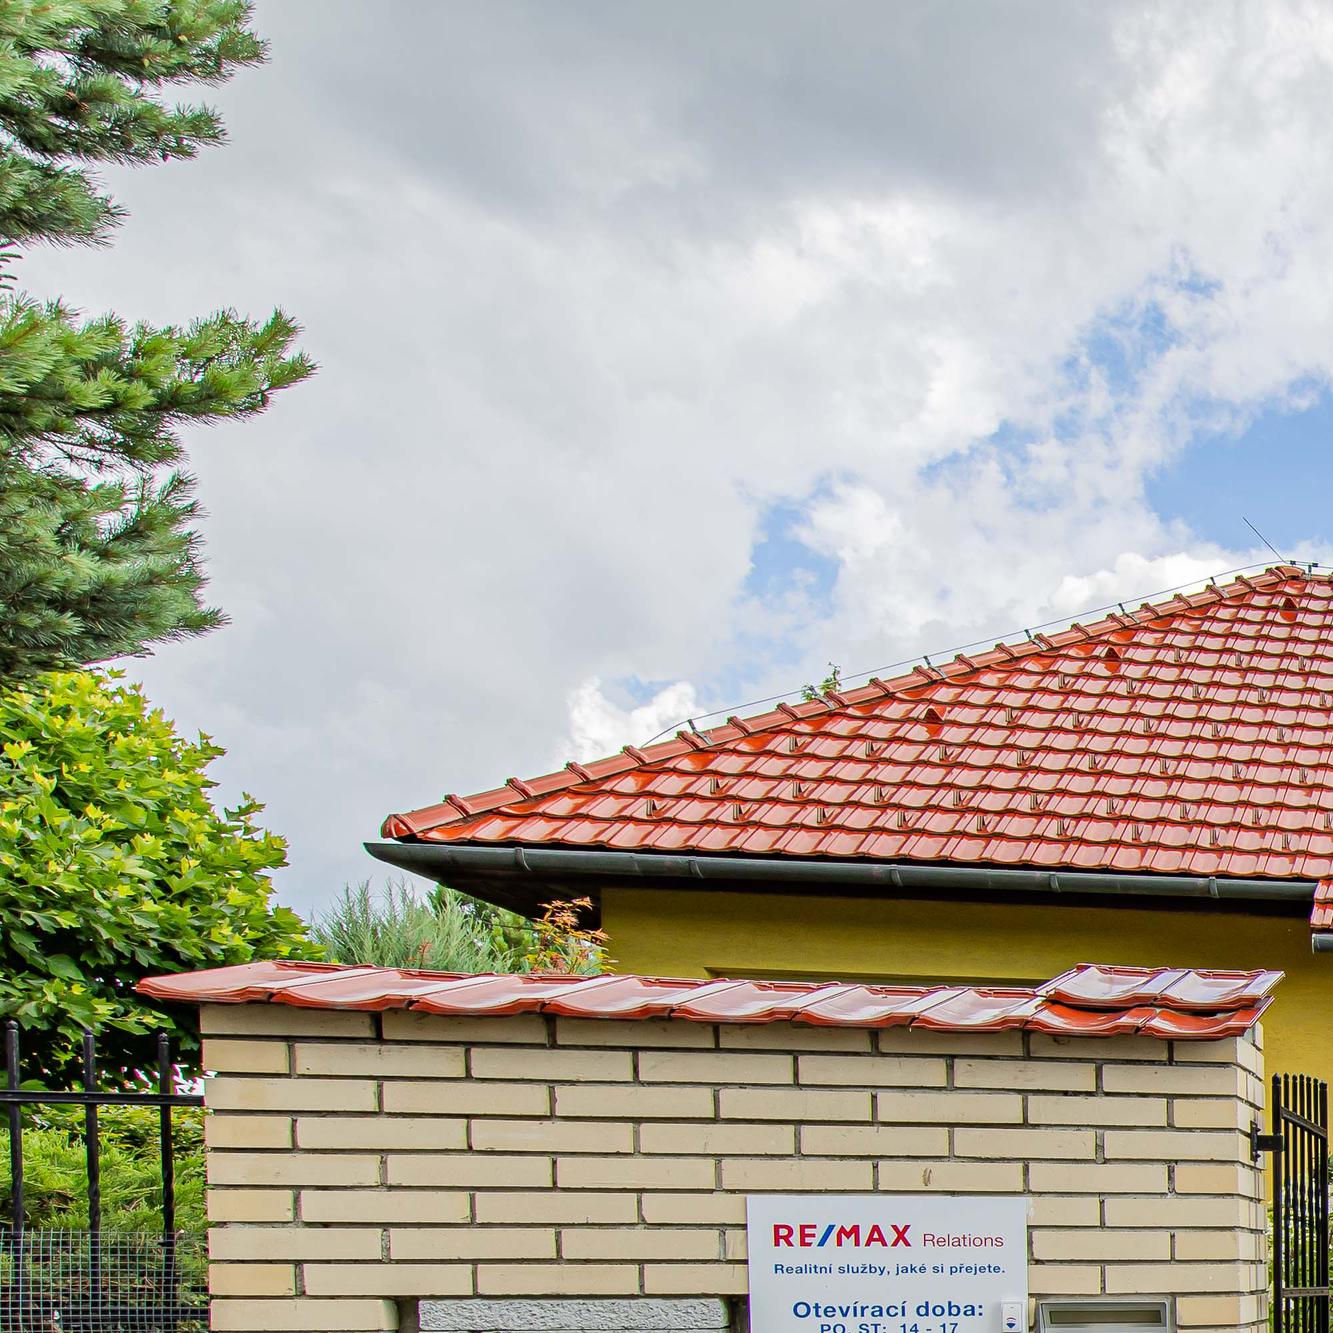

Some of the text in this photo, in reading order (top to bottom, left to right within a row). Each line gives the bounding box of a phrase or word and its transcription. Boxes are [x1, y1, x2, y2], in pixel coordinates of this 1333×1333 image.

[773, 1223, 1005, 1248] RE/MAX Relations
[773, 1263, 1006, 1276] Realitní služby, jaké si přejete.
[792, 1300, 984, 1319] Otevírací doba:
